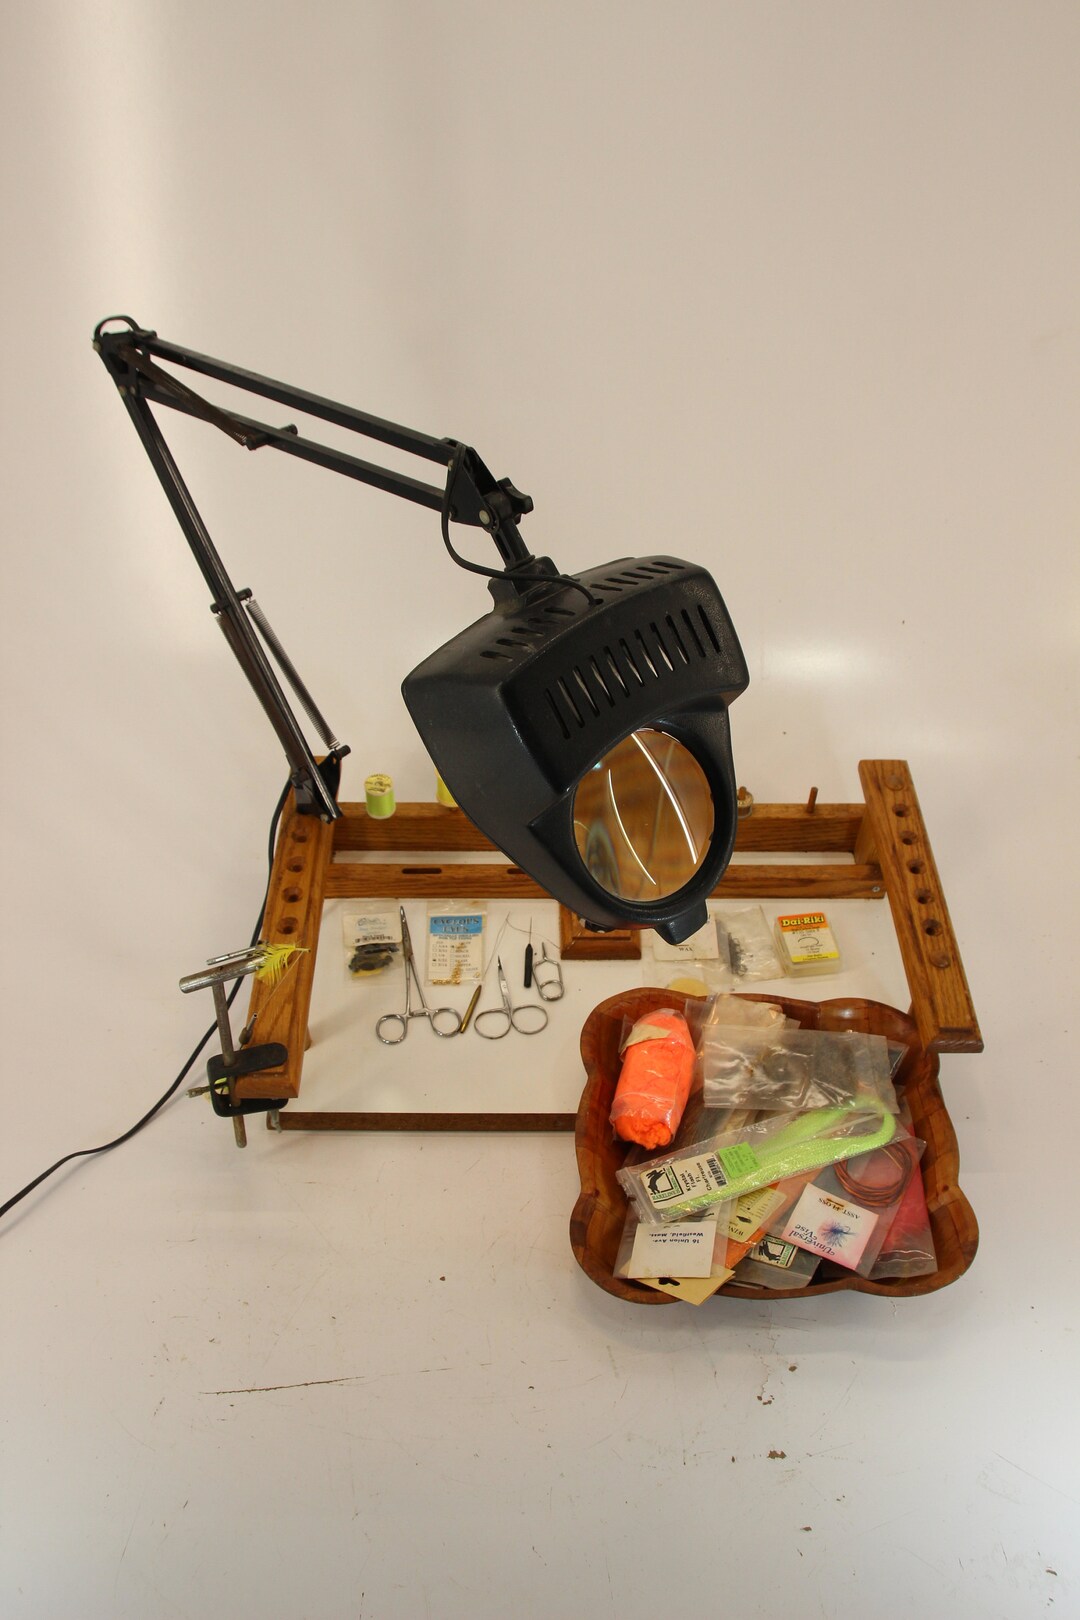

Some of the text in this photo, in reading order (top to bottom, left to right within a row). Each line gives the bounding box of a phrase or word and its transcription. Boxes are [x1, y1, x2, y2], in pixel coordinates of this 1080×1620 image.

[680, 1173, 691, 1191] Krystal
[795, 1224, 818, 1240] Vise
[788, 1230, 835, 1256] Universal
